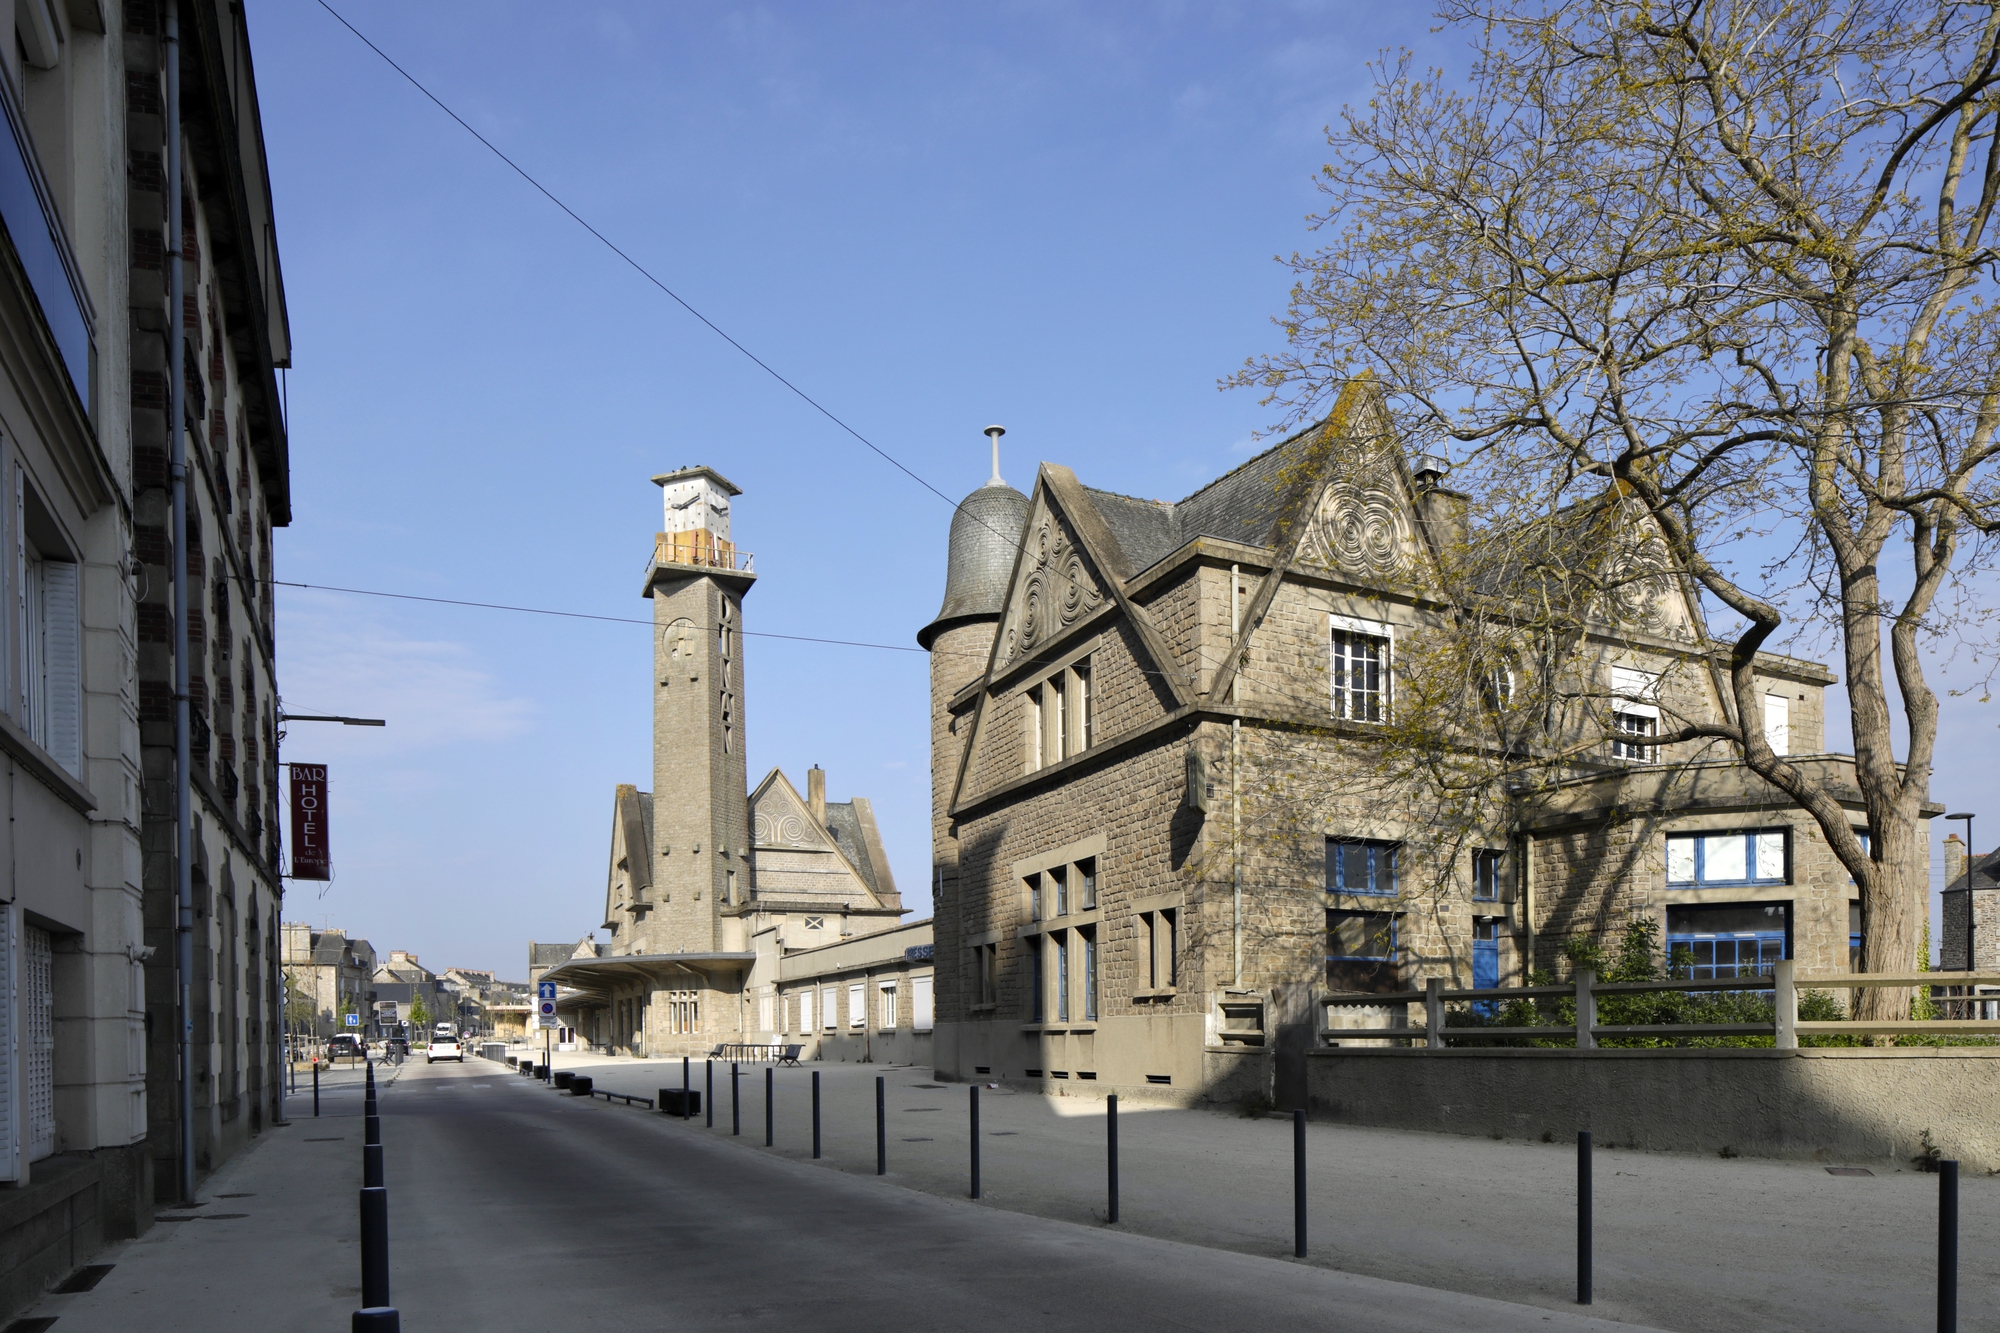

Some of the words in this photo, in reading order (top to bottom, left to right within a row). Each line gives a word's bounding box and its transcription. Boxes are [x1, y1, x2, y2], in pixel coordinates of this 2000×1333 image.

[292, 767, 325, 782] BAR
[301, 784, 318, 847] HOTEL
[294, 856, 327, 866] L'Europe
